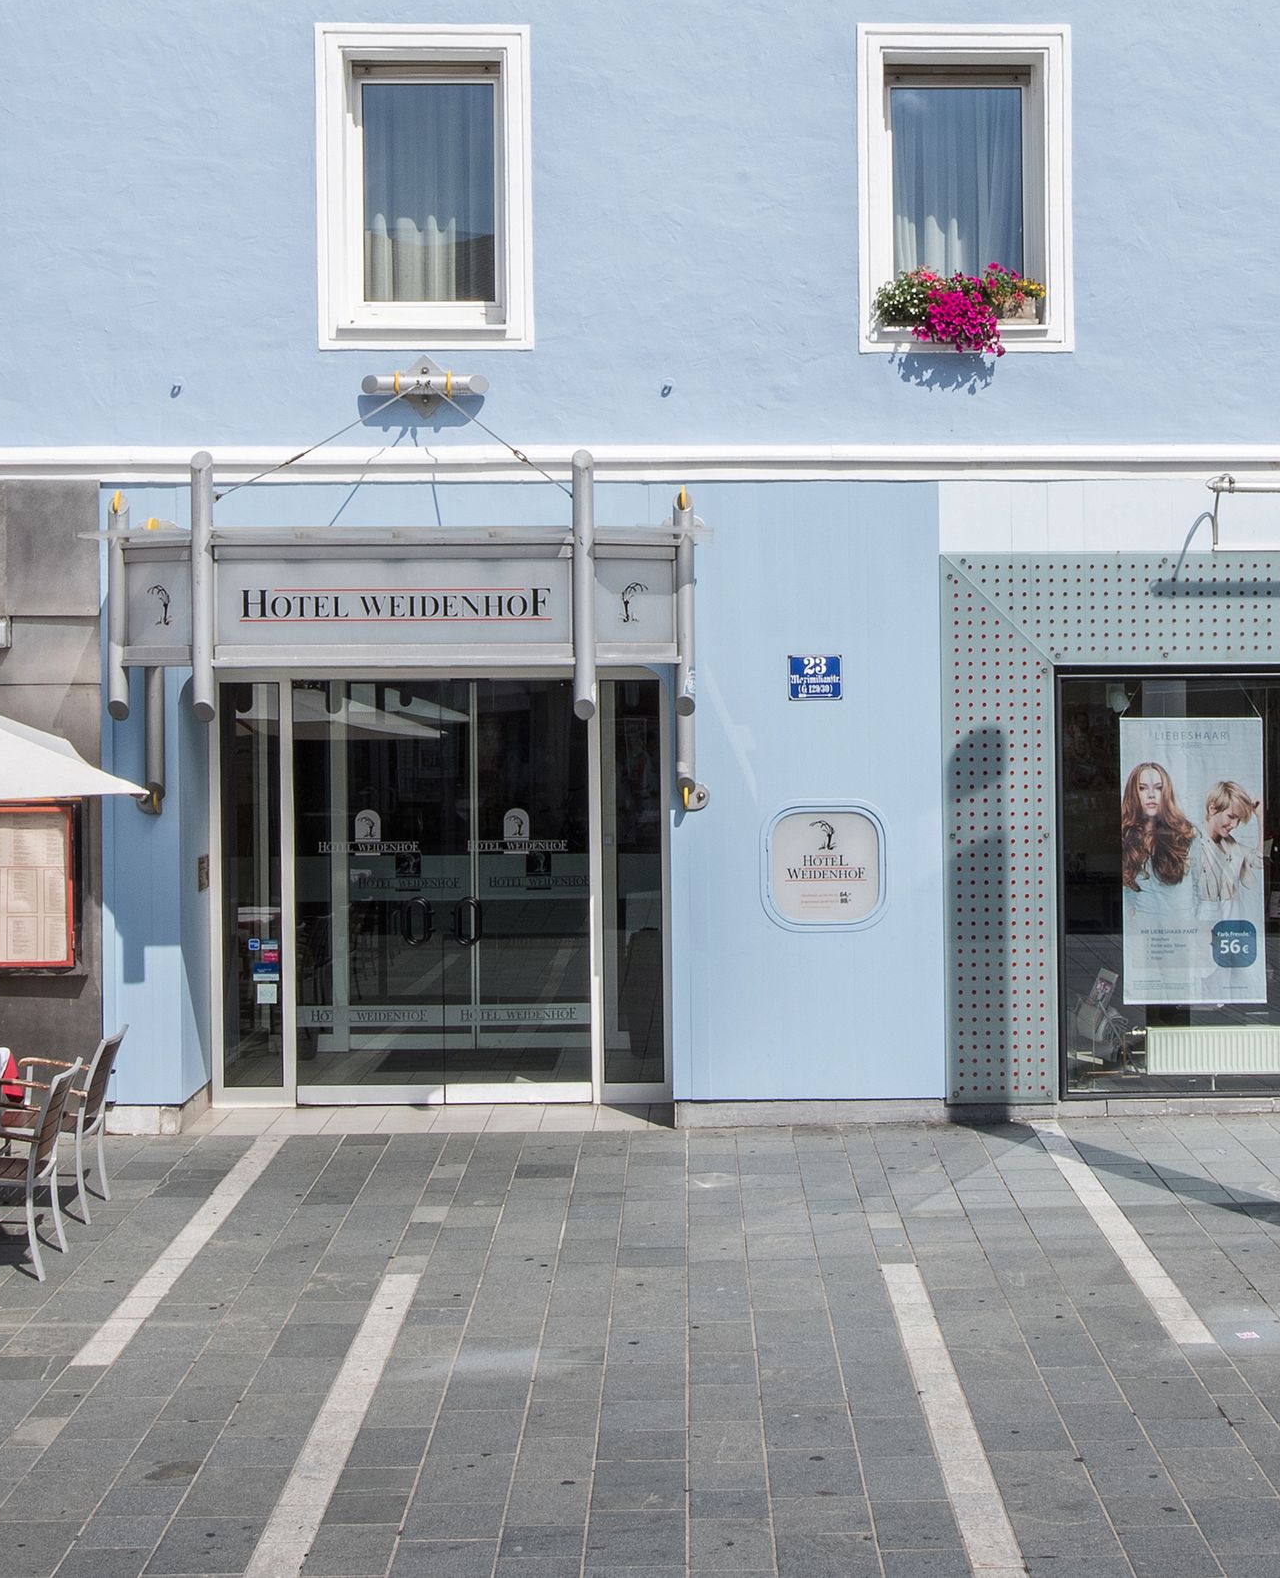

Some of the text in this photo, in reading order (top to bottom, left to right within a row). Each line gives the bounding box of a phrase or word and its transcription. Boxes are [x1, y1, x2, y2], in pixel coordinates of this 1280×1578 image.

[240, 587, 552, 619] HOTEL WEIDENHOF
[803, 657, 827, 675] 23
[1154, 730, 1227, 742] LIEBESHAAR
[357, 841, 420, 852] WEIDENHOF
[506, 839, 569, 851] WEIDENHOF
[803, 854, 849, 867] HOTEL
[787, 867, 866, 879] WEIDENHOF
[356, 1008, 428, 1021] WEIDENHOF
[506, 1007, 577, 1020] WEIDENHOF
